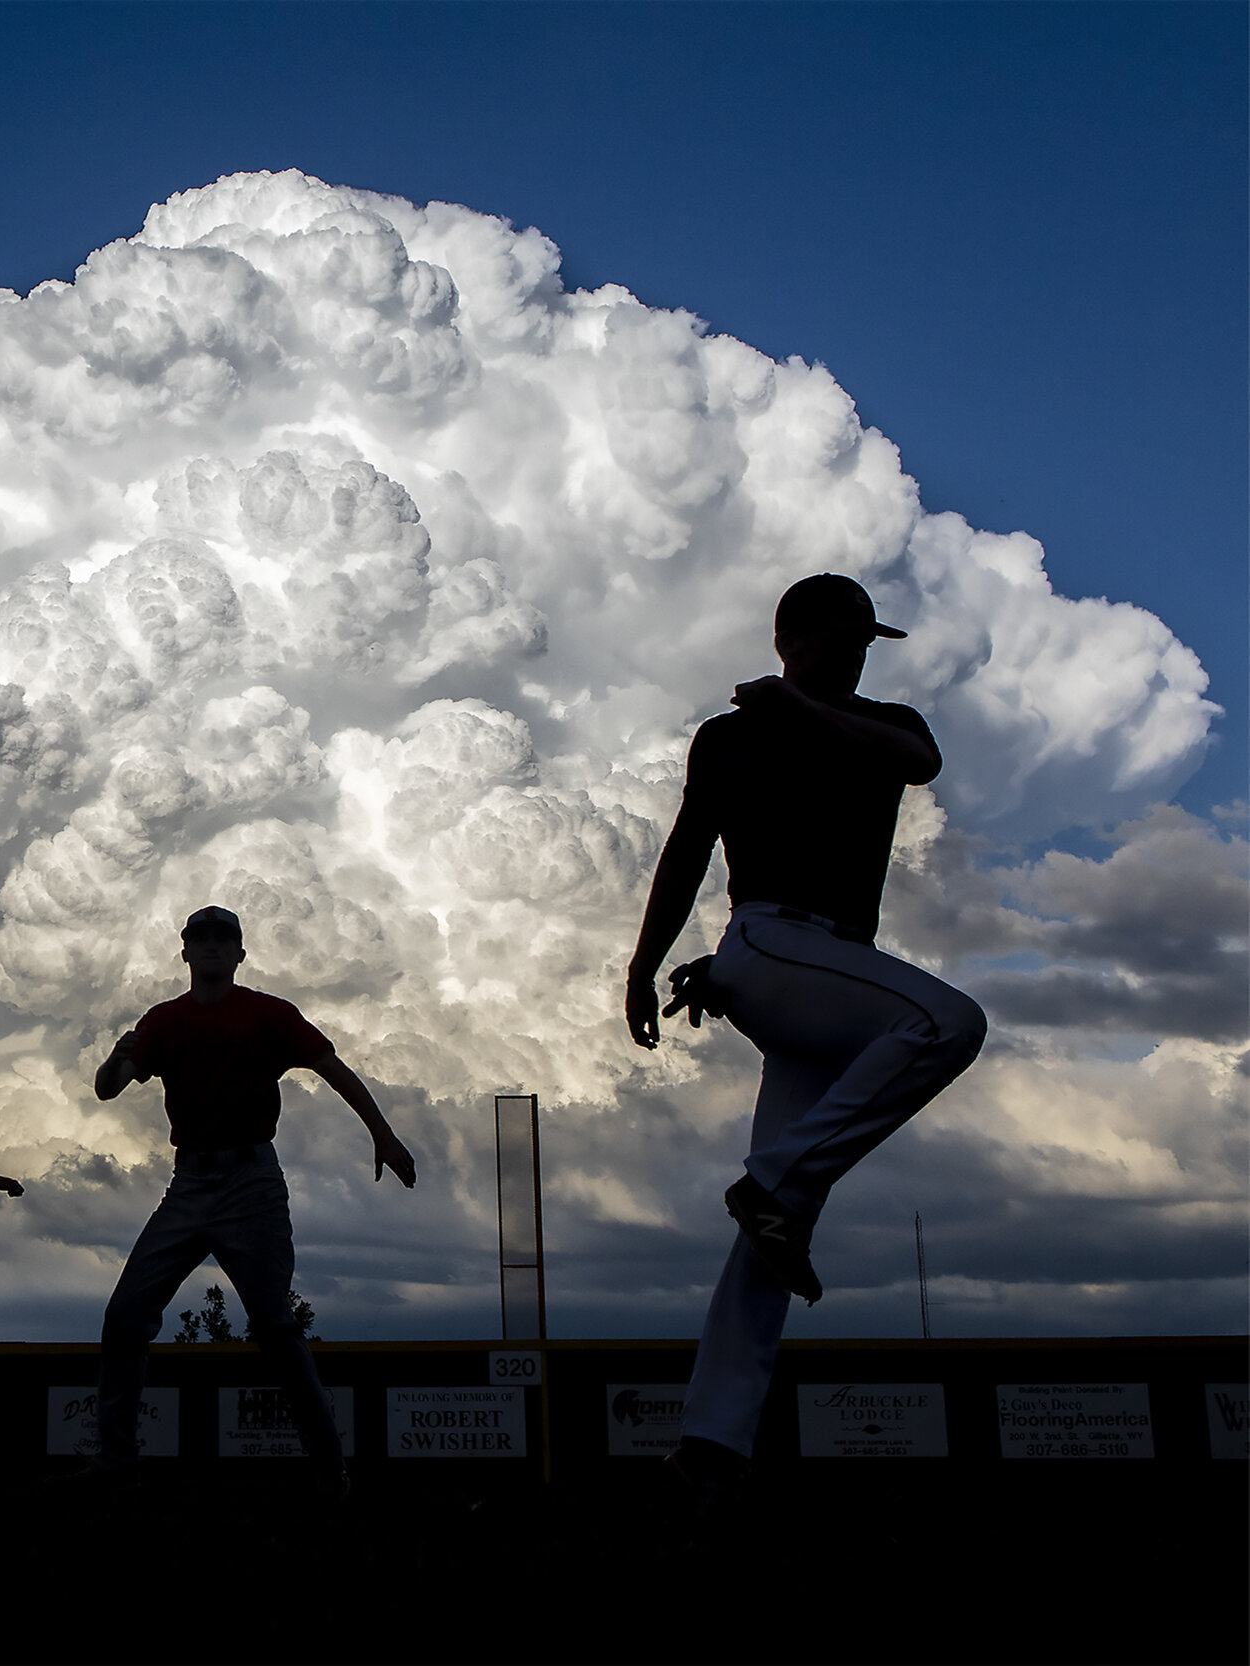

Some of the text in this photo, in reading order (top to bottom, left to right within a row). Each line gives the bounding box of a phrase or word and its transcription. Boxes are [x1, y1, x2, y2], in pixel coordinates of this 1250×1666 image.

[495, 1358, 535, 1377] 320
[397, 1392, 514, 1402] IN LOVING MEMORY OF
[813, 1385, 928, 1407] ARBUCKLE
[1018, 1386, 1050, 1395] Building
[1000, 1399, 1083, 1413] 2 Guy's Deco
[410, 1410, 504, 1428] ROBERT
[840, 1410, 904, 1421] LODGE
[1000, 1411, 1149, 1430] FlooringAmerica
[400, 1432, 512, 1450] SWISHER
[1127, 1432, 1143, 1440] WY
[1026, 1443, 1129, 1456] 307-686-5110
